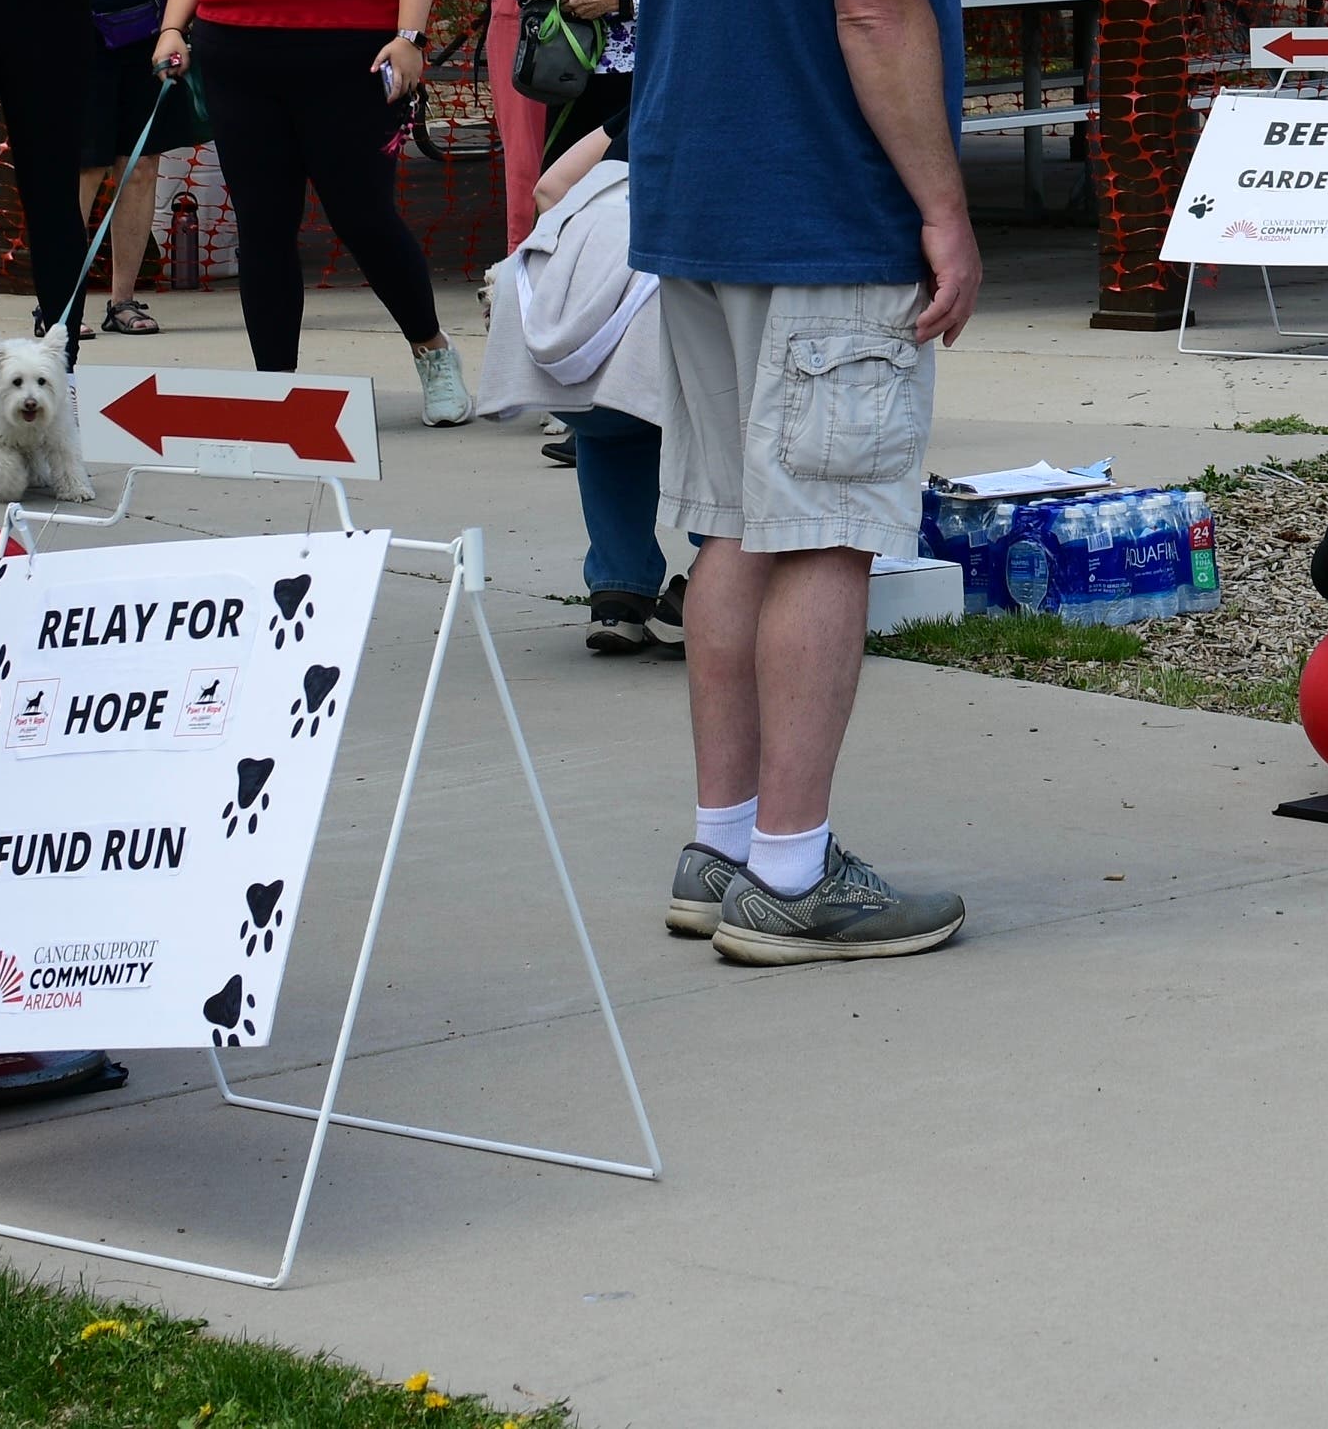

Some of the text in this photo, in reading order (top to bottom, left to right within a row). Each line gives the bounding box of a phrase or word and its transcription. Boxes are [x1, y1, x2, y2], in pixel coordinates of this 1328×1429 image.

[1260, 226, 1327, 235] COMMUNITY
[1193, 526, 1209, 540] 24
[1125, 540, 1180, 569] AQUAFINA
[38, 597, 245, 650] RELAY FOR
[63, 689, 169, 736] HOPE
[101, 826, 187, 871] RUN
[33, 940, 159, 964] CANCER SUPPORT
[29, 962, 154, 990] COMMUNITY
[23, 991, 82, 1011] ARIZONA
